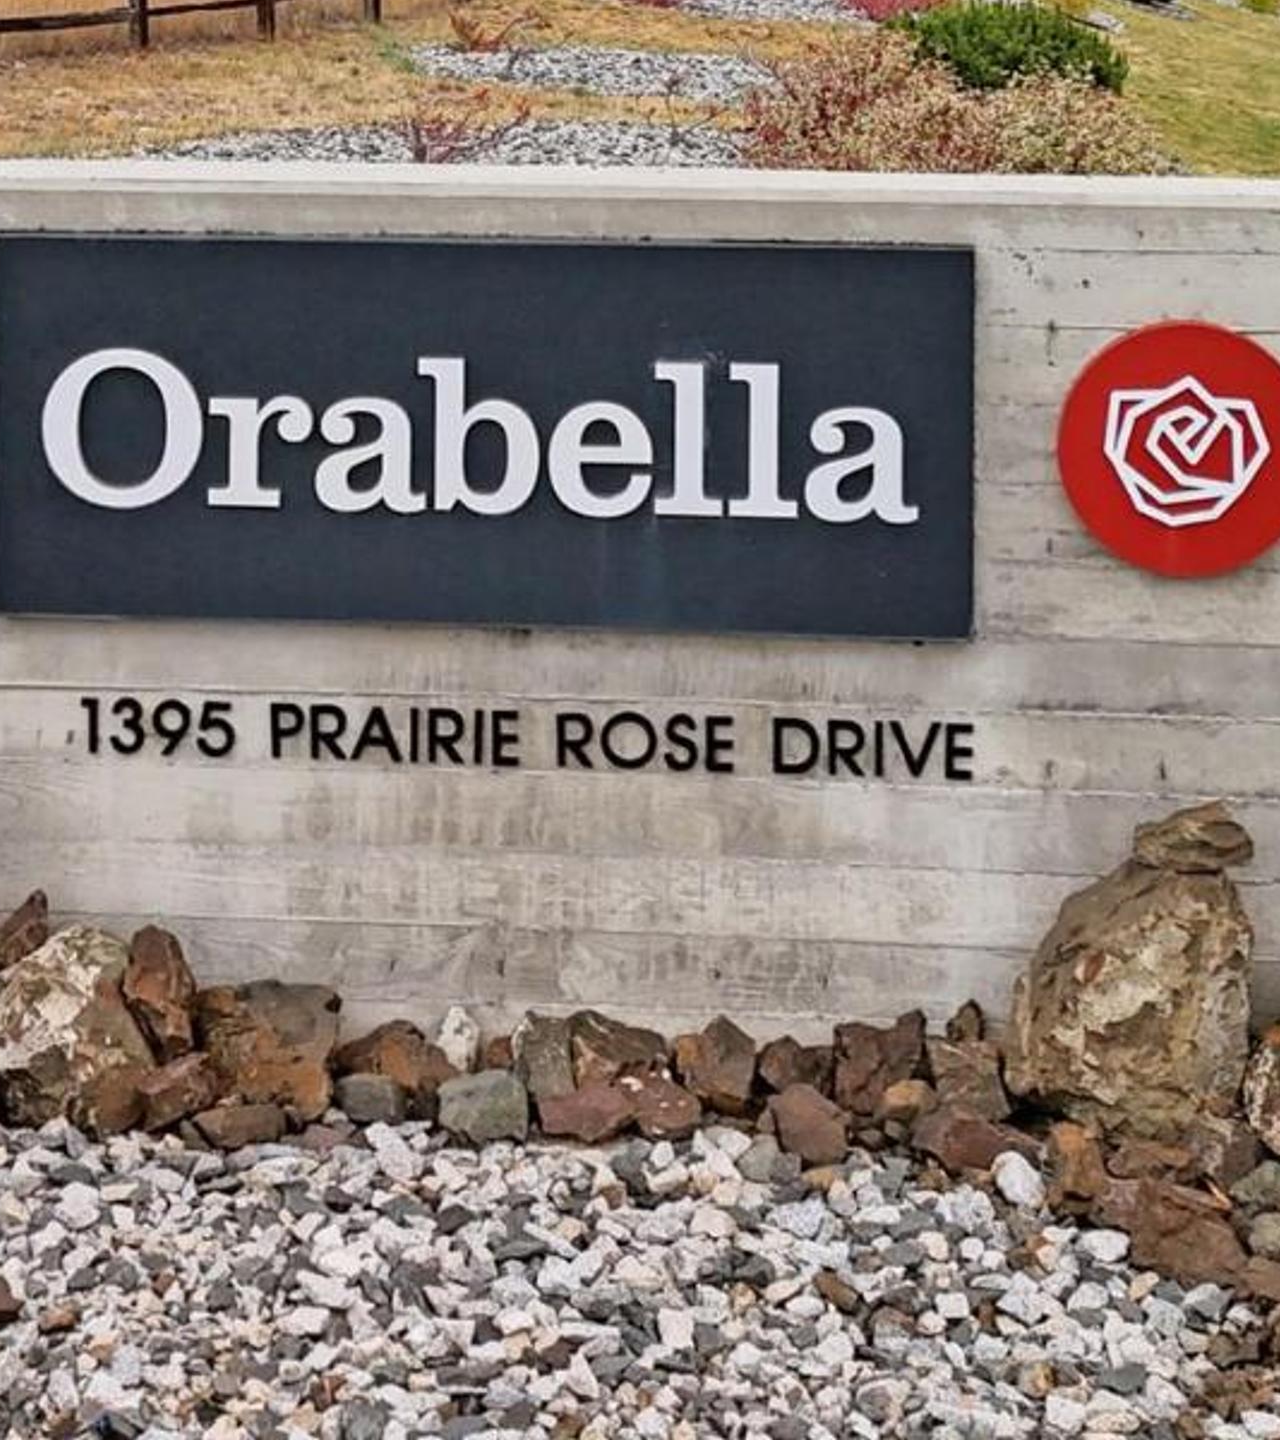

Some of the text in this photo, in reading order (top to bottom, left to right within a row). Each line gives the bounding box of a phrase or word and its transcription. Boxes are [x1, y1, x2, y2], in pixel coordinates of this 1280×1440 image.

[41, 346, 920, 525] Orabella
[79, 696, 975, 783] 1395 PRAIRIE ROSE DRIVE
